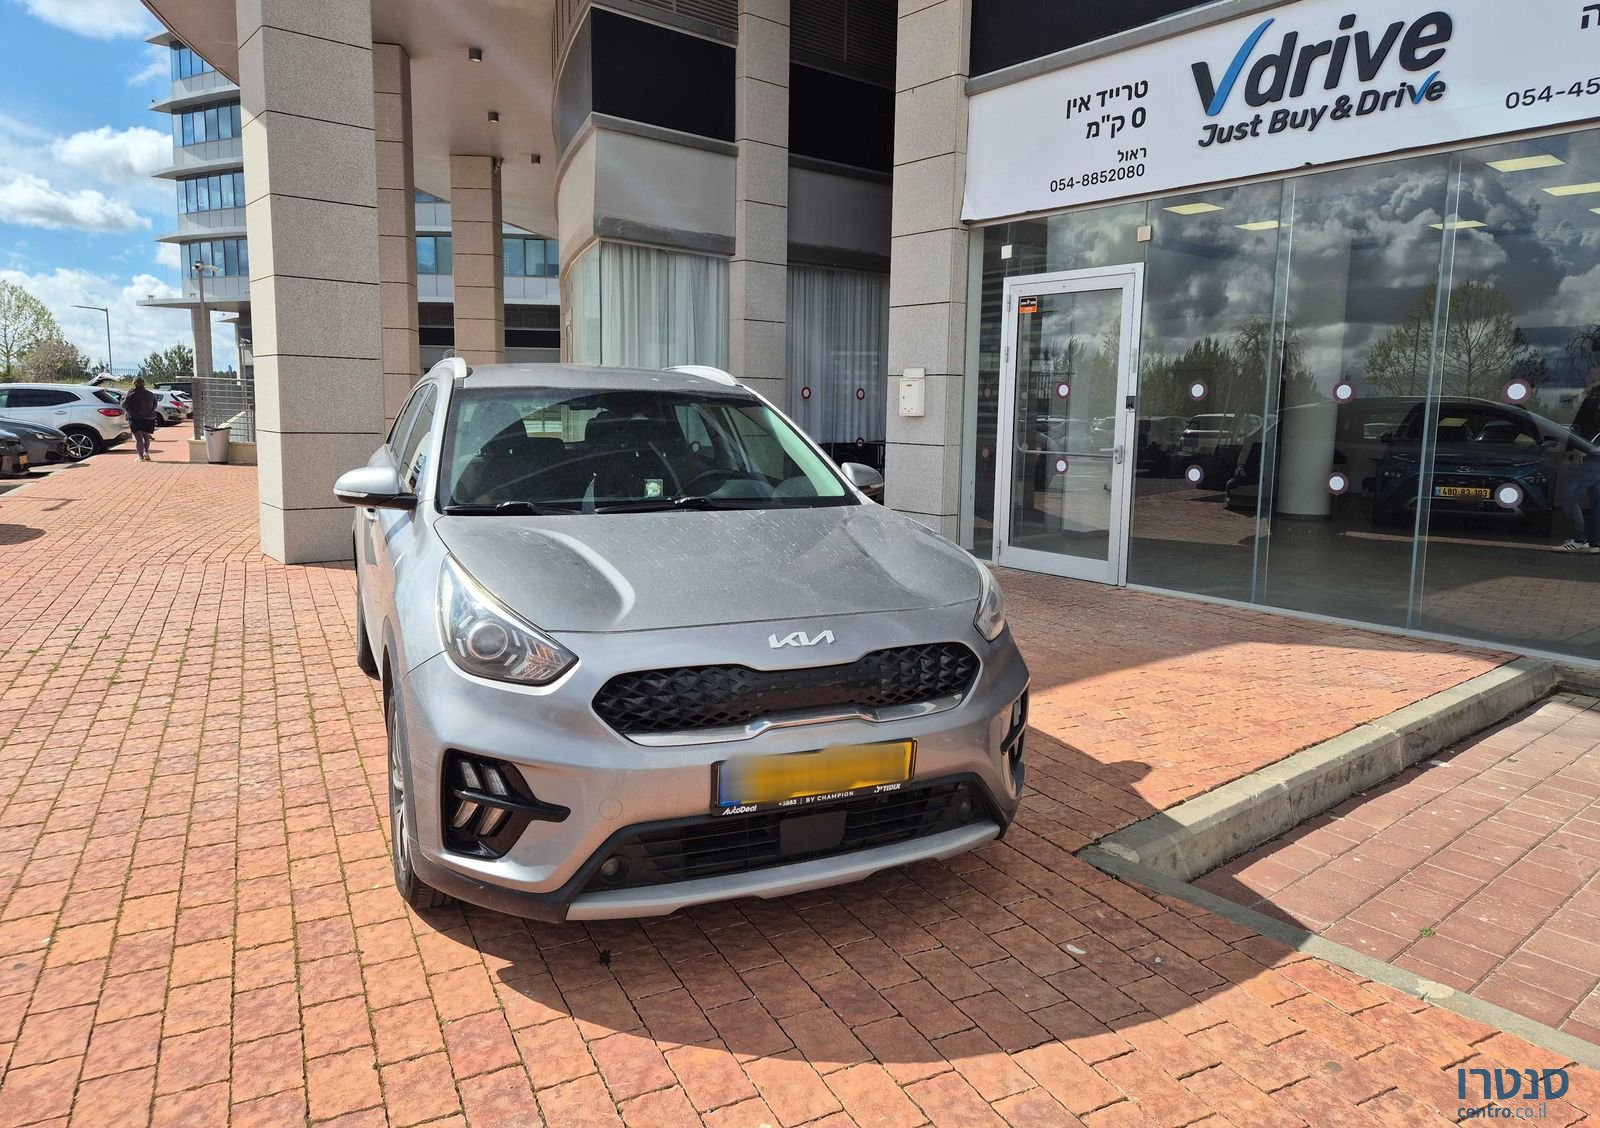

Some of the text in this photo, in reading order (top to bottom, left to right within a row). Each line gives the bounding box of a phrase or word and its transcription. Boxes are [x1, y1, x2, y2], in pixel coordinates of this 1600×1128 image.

[1066, 80, 1149, 119] טרייד אין
[1198, 70, 1446, 147] Just Buy & Drive
[1131, 106, 1147, 129] 0
[1117, 147, 1147, 163] ראול
[1050, 163, 1145, 193] 054-8852080
[768, 629, 835, 649] KIA
[805, 796, 815, 804] BY
[817, 790, 854, 802] CHAMPION
[722, 804, 758, 816] AutoDeal
